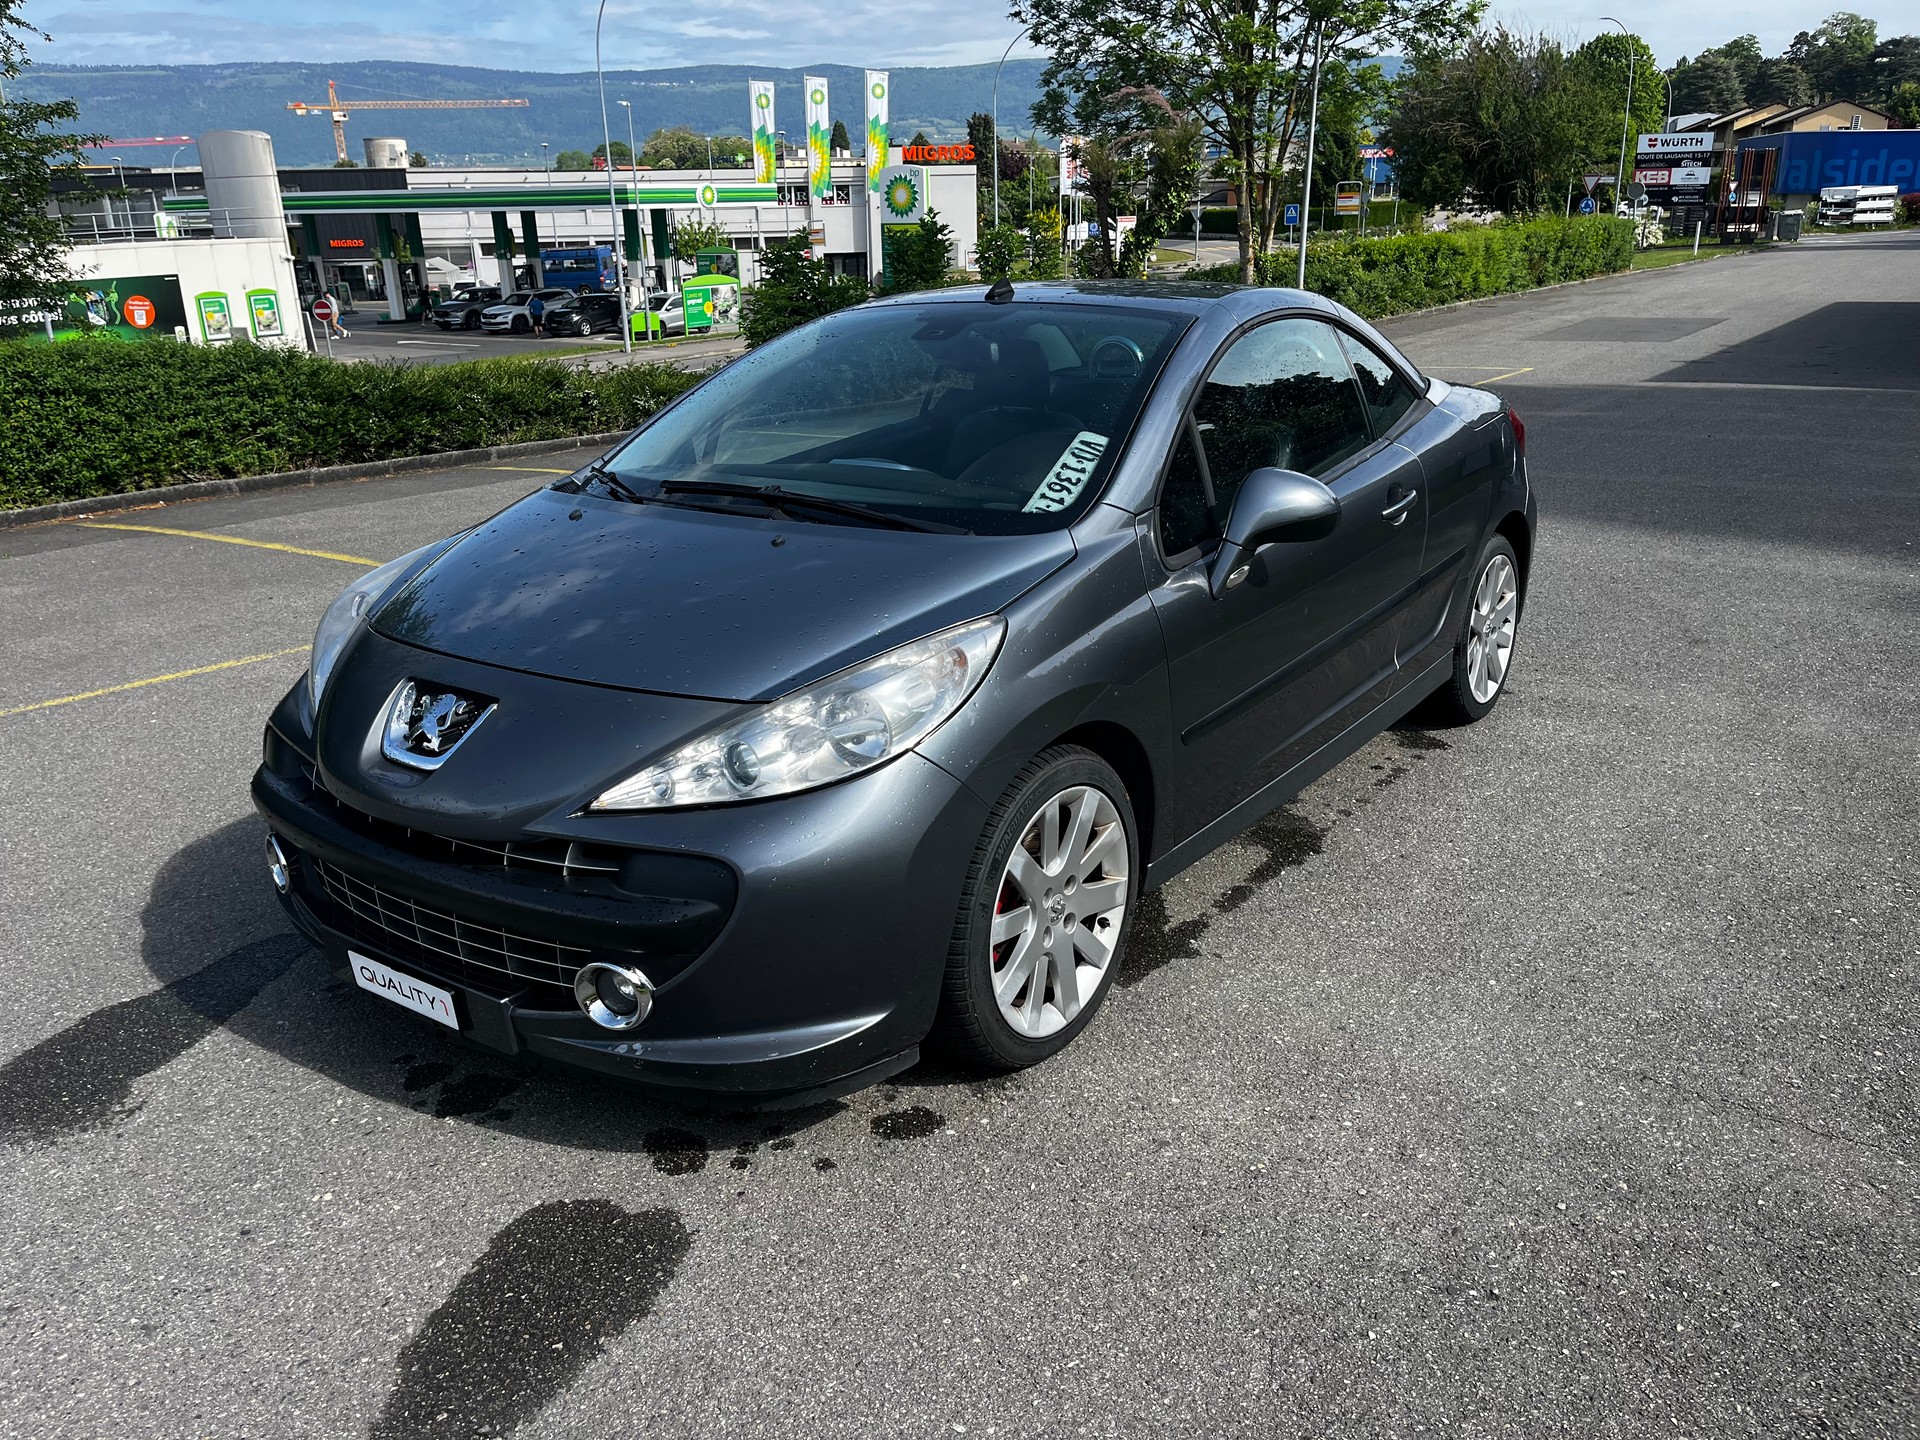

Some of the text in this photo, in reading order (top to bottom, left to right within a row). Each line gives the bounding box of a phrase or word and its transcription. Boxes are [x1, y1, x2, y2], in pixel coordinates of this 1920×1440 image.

[1660, 137, 1704, 147] WÜRTH
[902, 145, 975, 161] MIGROS
[909, 168, 920, 177] bp
[1635, 171, 1669, 184] KEB
[330, 239, 365, 248] MIGROS
